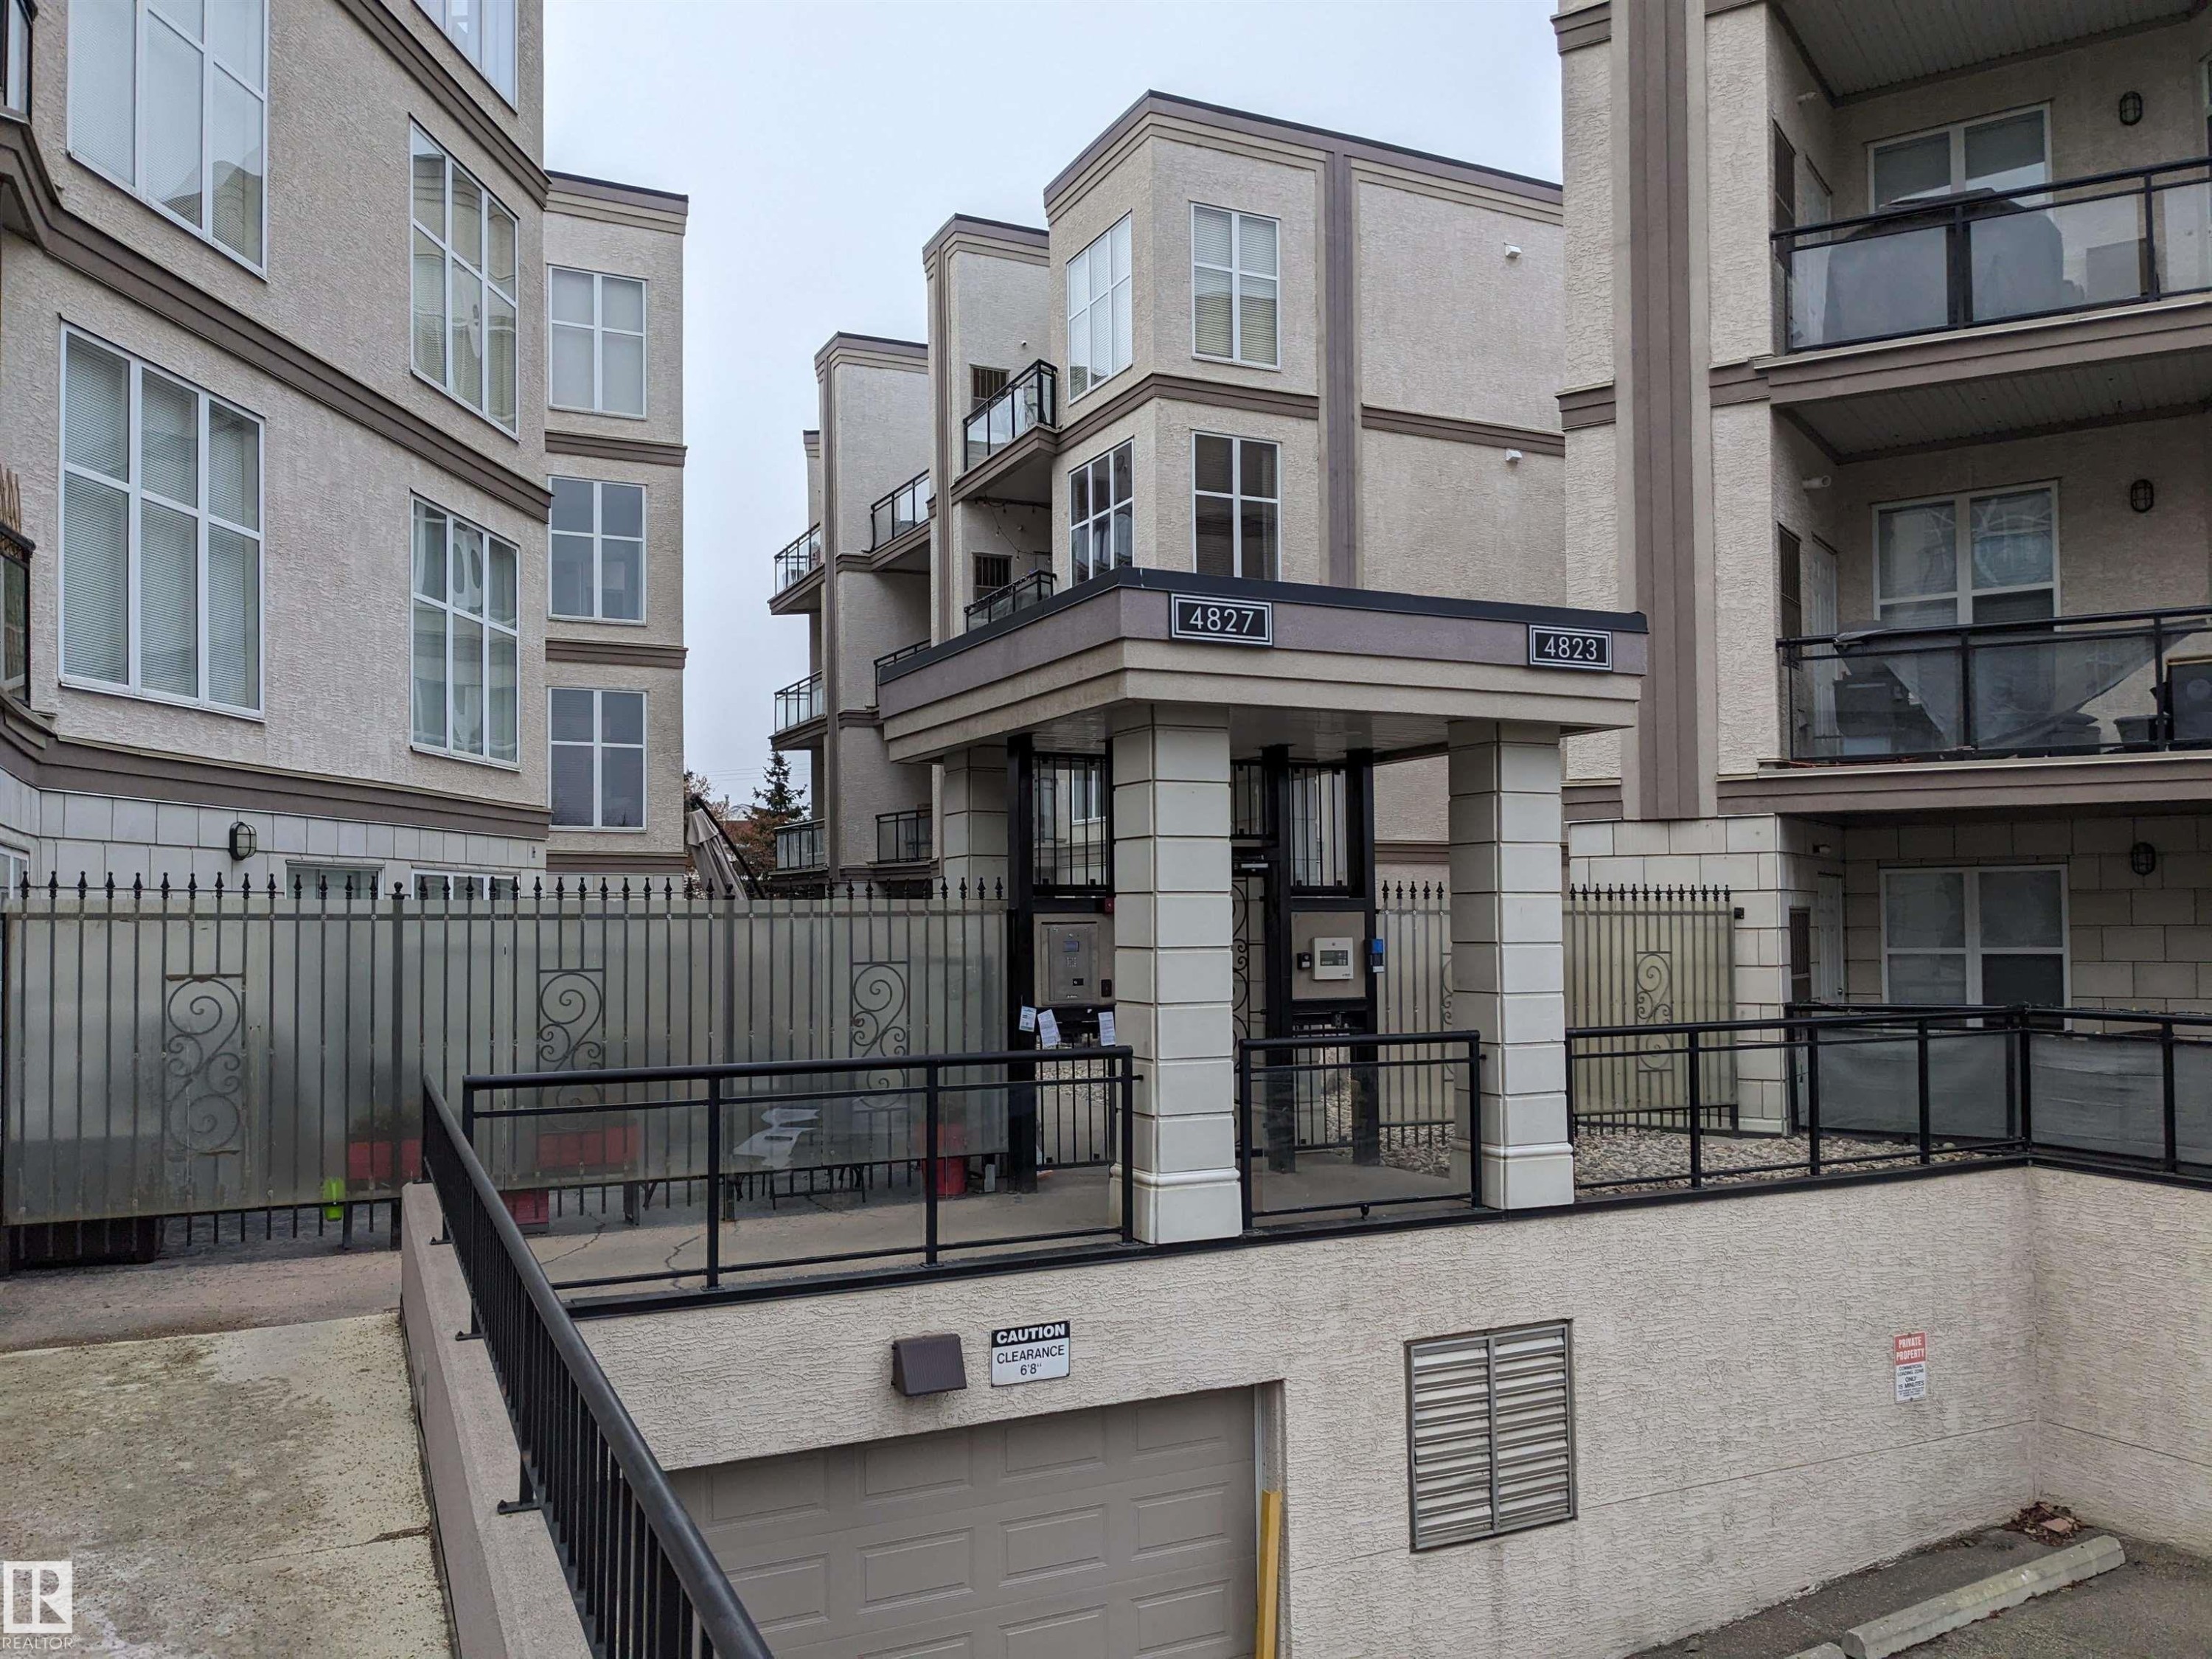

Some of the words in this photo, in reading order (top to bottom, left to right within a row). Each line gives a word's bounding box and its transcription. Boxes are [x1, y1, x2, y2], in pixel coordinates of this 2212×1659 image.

[1189, 605, 1255, 634] 4827
[1544, 636, 1598, 661] 4823
[996, 1324, 1065, 1344] CAUTION
[1899, 1336, 1922, 1349] PRIVATE
[997, 1345, 1065, 1364] CLEARANCE
[1896, 1348, 1924, 1361] PROPERTY
[1904, 1380, 1924, 1388] MINUTES
